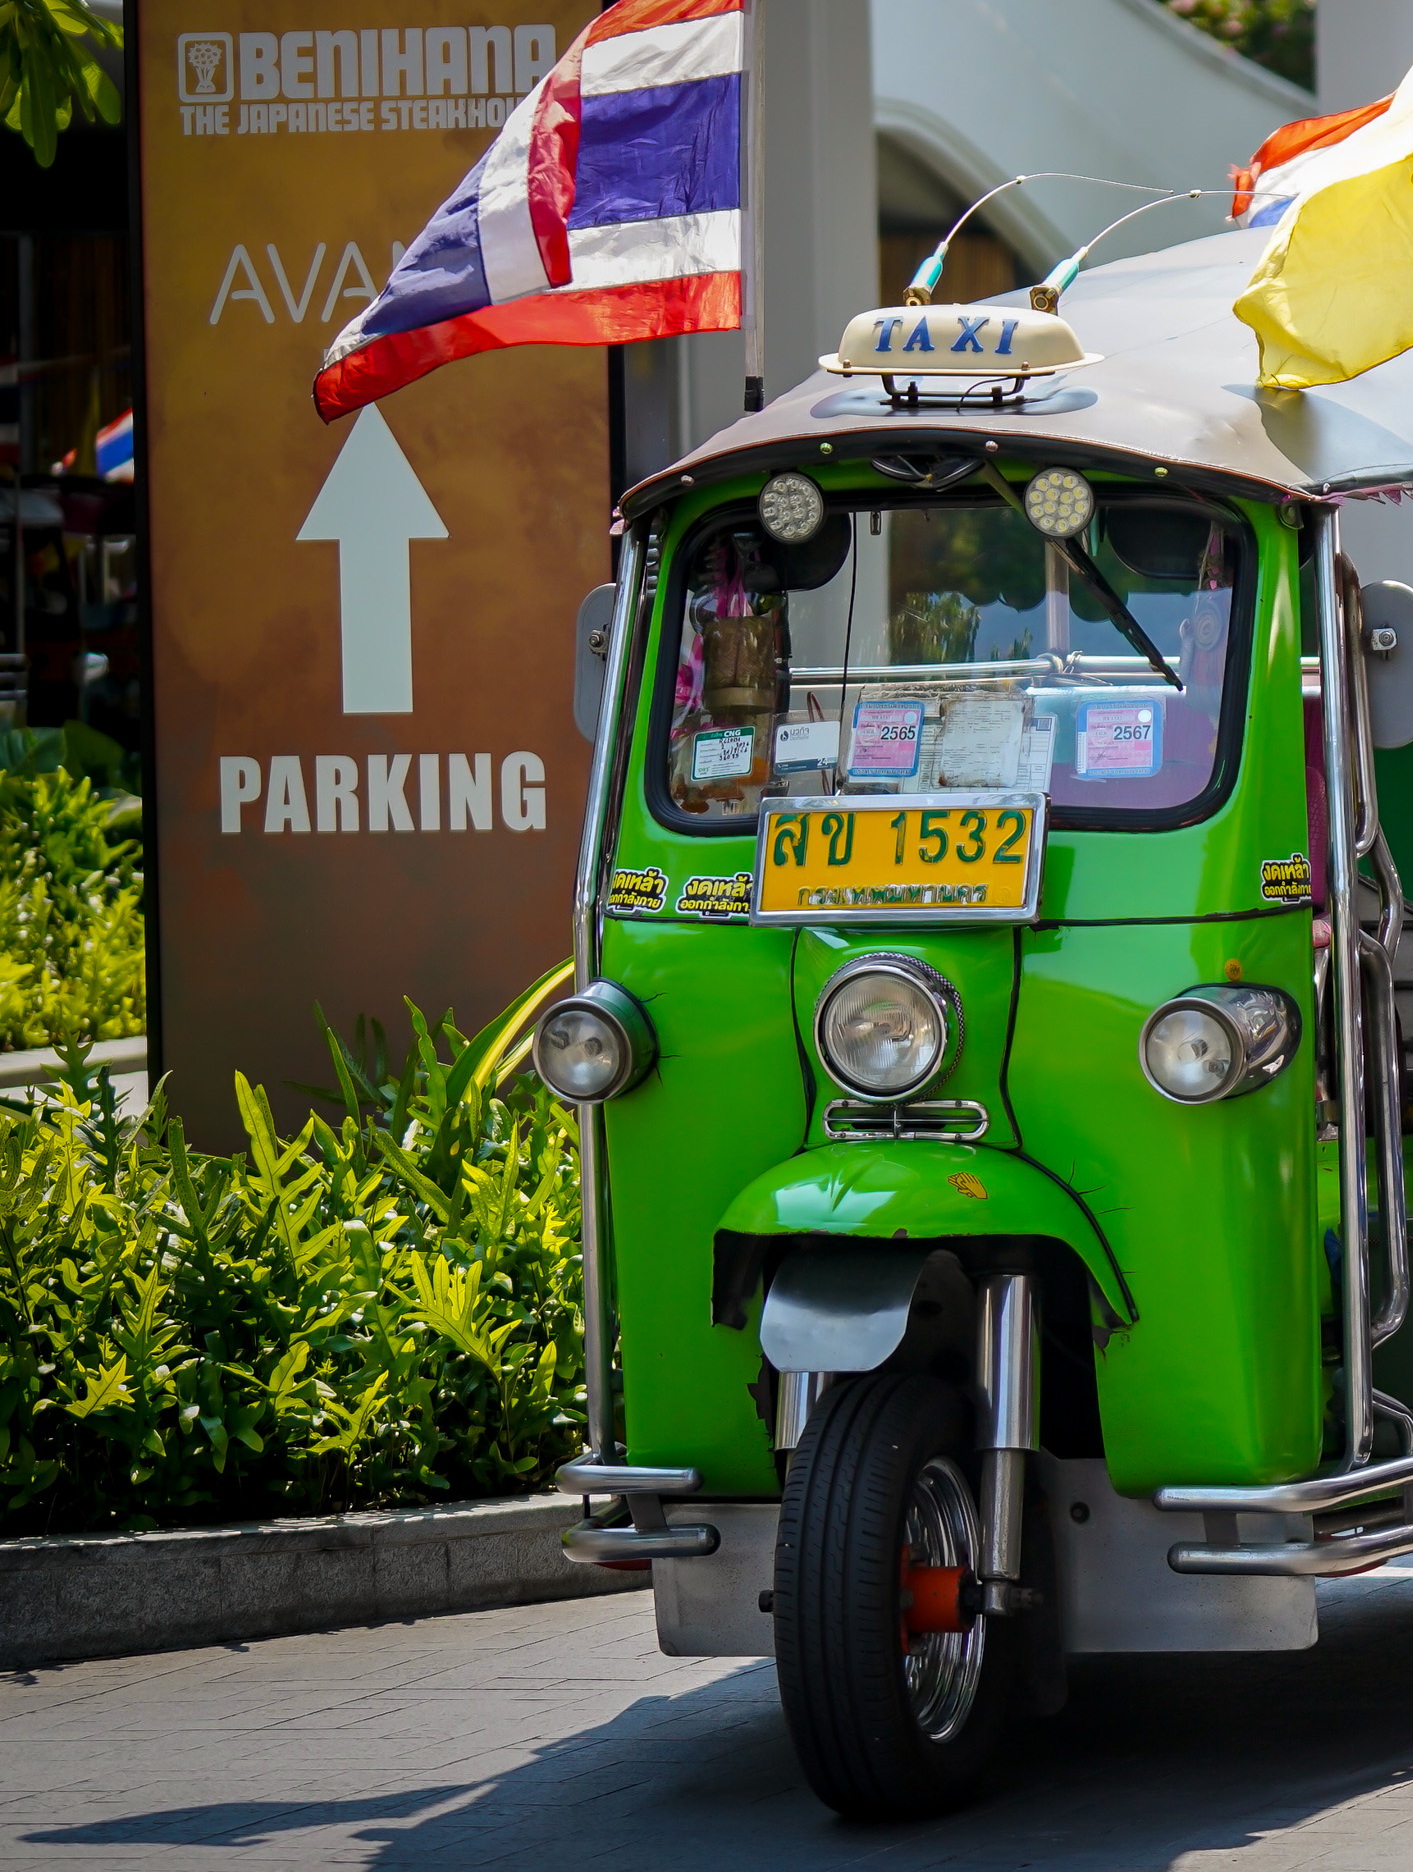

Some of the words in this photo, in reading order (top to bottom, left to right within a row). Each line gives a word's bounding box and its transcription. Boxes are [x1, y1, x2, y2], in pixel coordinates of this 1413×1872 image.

[239, 24, 557, 100] BENIHANA
[179, 105, 230, 135] THE
[237, 101, 376, 134] JAPANESE
[210, 241, 407, 325] AVA
[873, 316, 1020, 354] TAXI
[724, 729, 741, 737] CNG
[880, 725, 916, 740] 2565
[1114, 725, 1151, 740] 2567
[220, 751, 547, 833] PARKING
[773, 811, 855, 866] สข
[890, 809, 1026, 865] 1532
[1263, 857, 1309, 880] งดเหล้า
[680, 897, 749, 911] ออกกำลังกา
[798, 884, 989, 905] กรงเทพมหานคร
